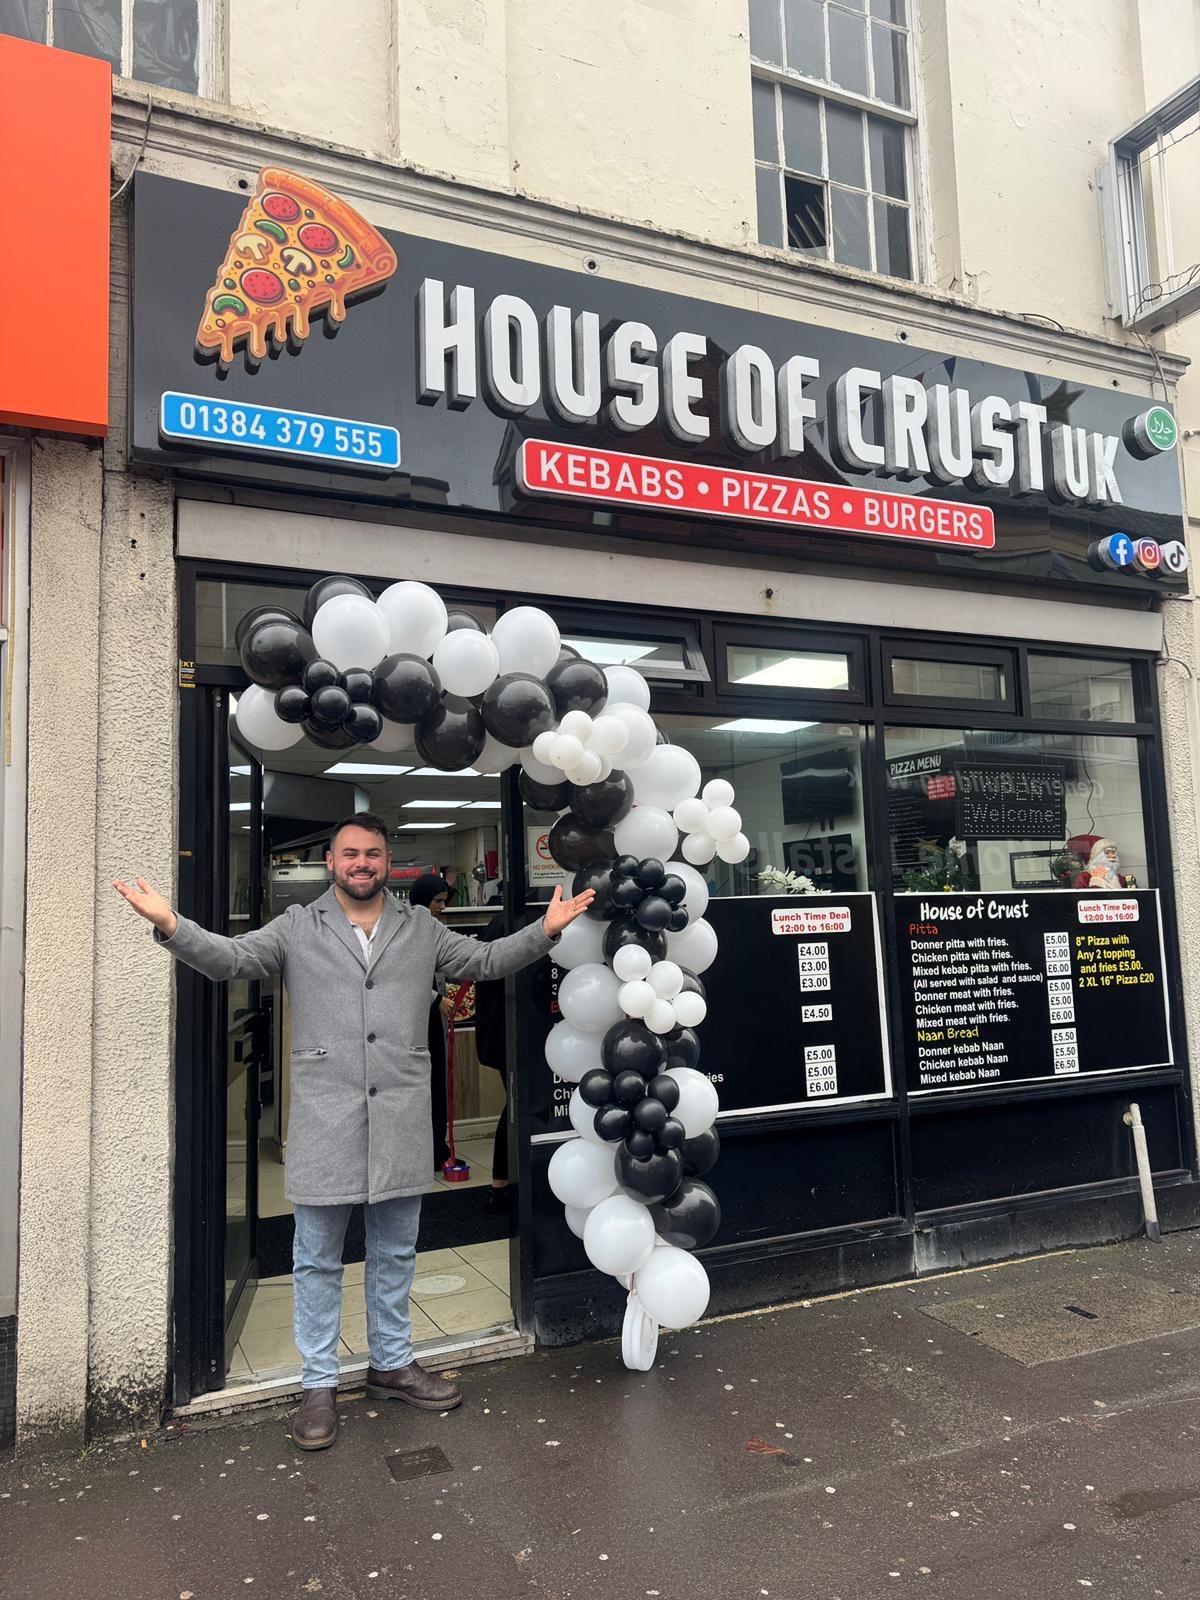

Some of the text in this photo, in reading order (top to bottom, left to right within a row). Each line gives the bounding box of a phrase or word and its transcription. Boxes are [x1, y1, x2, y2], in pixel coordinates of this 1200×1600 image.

[418, 278, 1123, 504] HOUSE OF CRUST UK
[179, 401, 383, 458] 01384 379 555
[1150, 416, 1173, 434] حلال
[539, 450, 983, 540] KEBABS PIZZAS BURGERS
[890, 754, 942, 776] PIZZA MENU
[984, 781, 1043, 801] OPEN
[970, 803, 1055, 823] Welcome
[920, 898, 1029, 921] House of Crust
[1079, 904, 1101, 912] Lunch
[1103, 903, 1120, 911] Time
[773, 911, 850, 922] Lunch Time Deal
[1084, 914, 1103, 922] 12:00
[779, 922, 845, 932] 12:00 to 16:00
[909, 923, 939, 935] Pitta
[911, 937, 1009, 950] Donner pitta with fries.
[1046, 935, 1067, 944] £5.00
[1075, 935, 1130, 946] 8" Pizza with
[800, 945, 826, 956] £4.00
[911, 950, 1013, 963] Chicken pitta with fries.
[1047, 949, 1068, 959] £5.00
[1077, 948, 1136, 961] Any 2 topping
[801, 960, 827, 971] £3.00
[912, 961, 1032, 976] Mixed kebab pitta with fries.
[1048, 963, 1069, 973] £6.00
[1080, 960, 1144, 973] and fries £5.00.
[802, 977, 828, 988] £3.00
[913, 972, 1044, 991] (All served with salad and sauce)
[1079, 973, 1155, 987] 2 XL 16" Pizza £20
[1049, 981, 1070, 992] £5.00
[914, 987, 1014, 1002] Donner meat with fries.
[1050, 995, 1071, 1006] £5.00
[804, 1007, 830, 1018] £4.50
[915, 999, 1019, 1015] Chicken meat with fries.
[916, 1012, 1010, 1029] Mixed meat with fries.
[1051, 1010, 1073, 1020] £6.00
[917, 1025, 979, 1042] Naan Bread
[1053, 1031, 1074, 1042] £5.50
[807, 1049, 832, 1060] £5.00
[918, 1041, 1004, 1057] Donner kebab Naan
[1055, 1046, 1076, 1057] £5.50
[919, 1053, 1009, 1071] Chicken kebab Naan
[1055, 1059, 1076, 1070] £6.50
[808, 1066, 833, 1077] £5.00
[920, 1068, 1000, 1084] Mixed kebab Naan
[809, 1080, 835, 1092] £6.00
